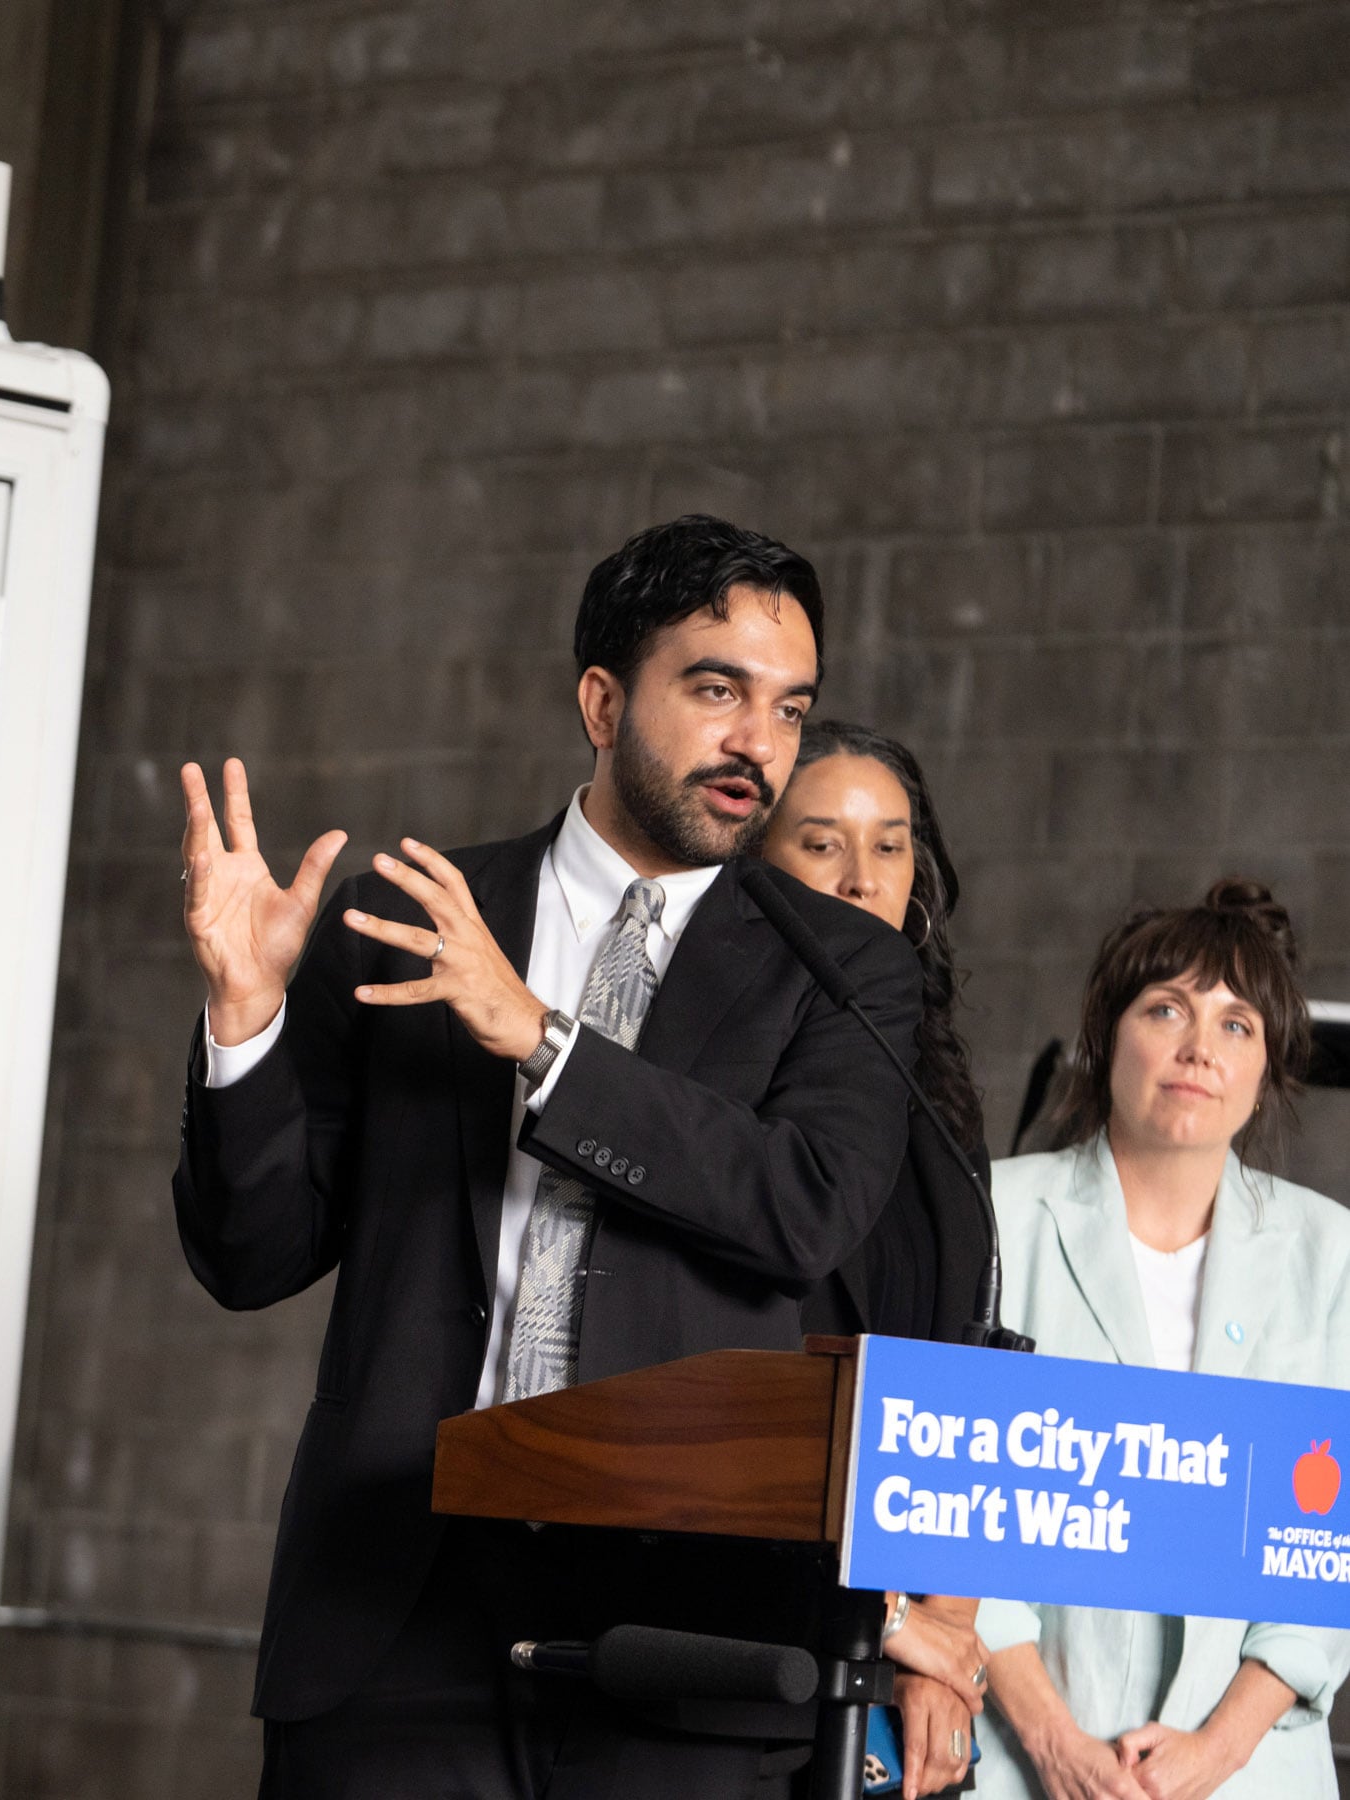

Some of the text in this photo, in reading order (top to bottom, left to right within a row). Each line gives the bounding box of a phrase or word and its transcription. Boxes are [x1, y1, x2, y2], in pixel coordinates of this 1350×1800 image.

[878, 1397, 1230, 1487] For a City That
[873, 1475, 1131, 1554] Can't Wait
[1283, 1526, 1332, 1547] OFFICE
[1333, 1533, 1342, 1549] of
[1262, 1545, 1350, 1583] MAYOR
